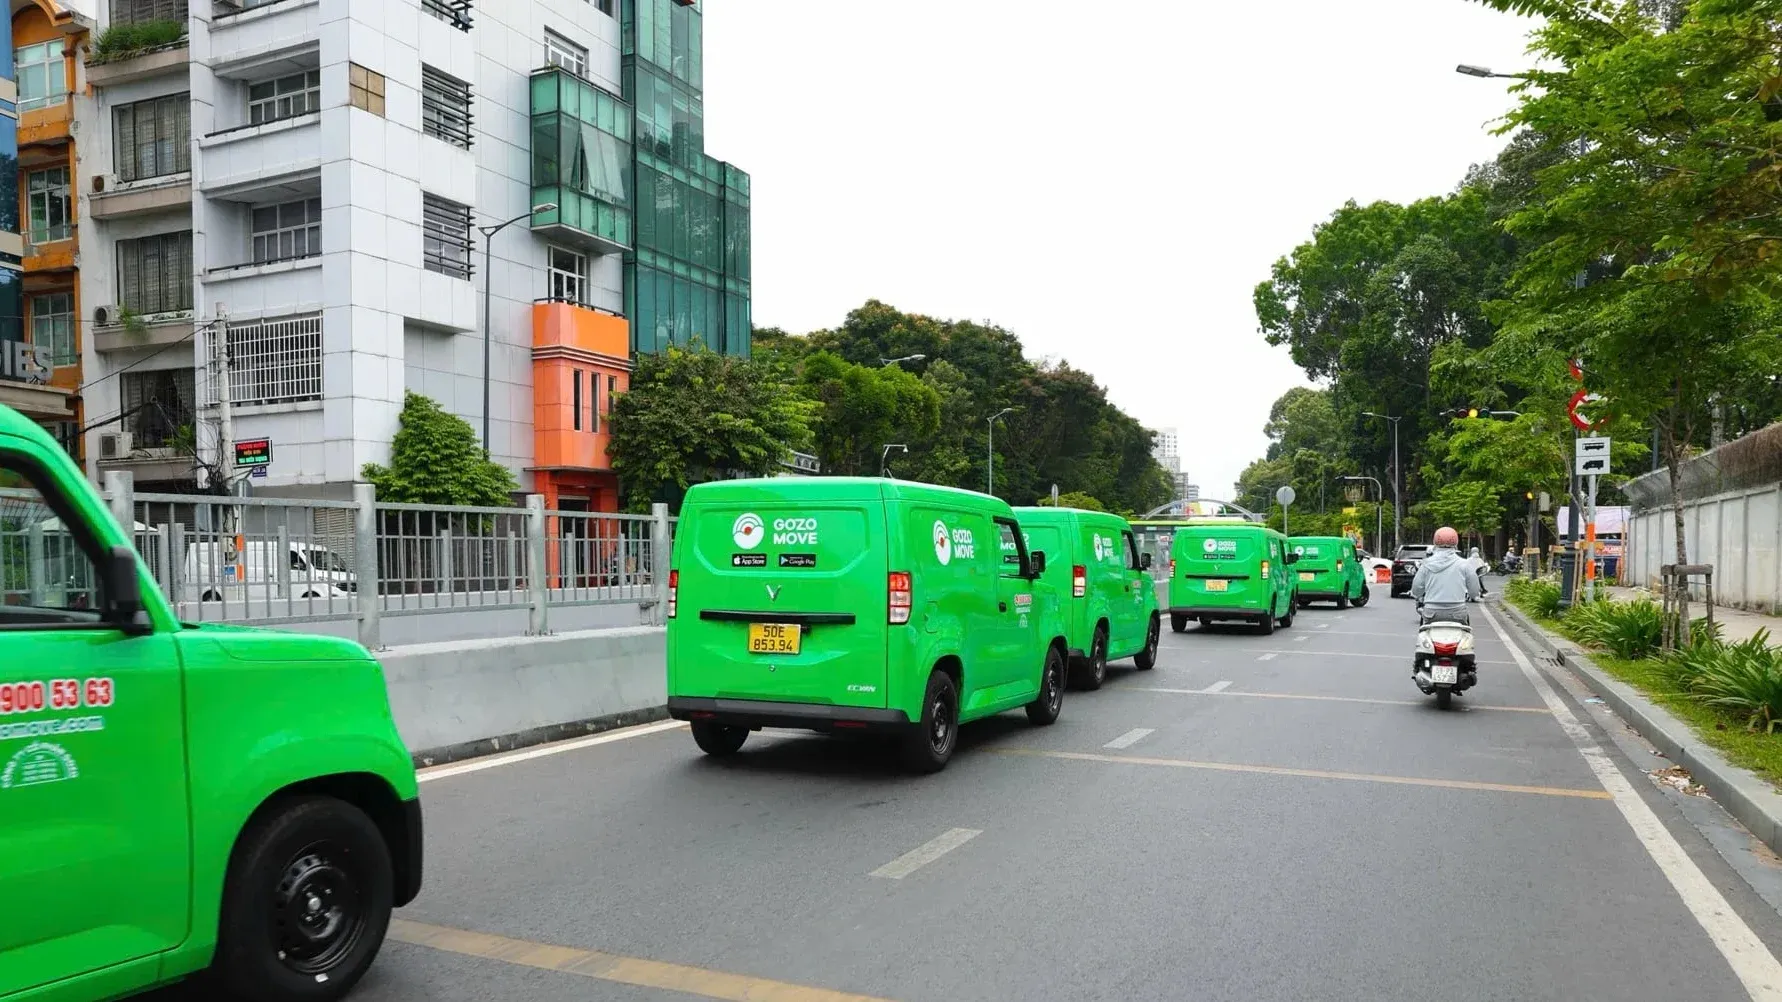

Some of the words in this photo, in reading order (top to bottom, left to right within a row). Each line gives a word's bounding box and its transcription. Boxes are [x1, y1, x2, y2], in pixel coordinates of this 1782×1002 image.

[0, 340, 53, 382] IES
[773, 518, 817, 531] GOZO
[773, 532, 817, 545] MOVE
[952, 529, 973, 544] GOZO
[954, 544, 975, 559] MOVE
[763, 625, 784, 638] 50E
[753, 638, 793, 651] 853.94
[0, 682, 44, 713] 900
[50, 680, 80, 709] 53
[85, 678, 114, 707] 63
